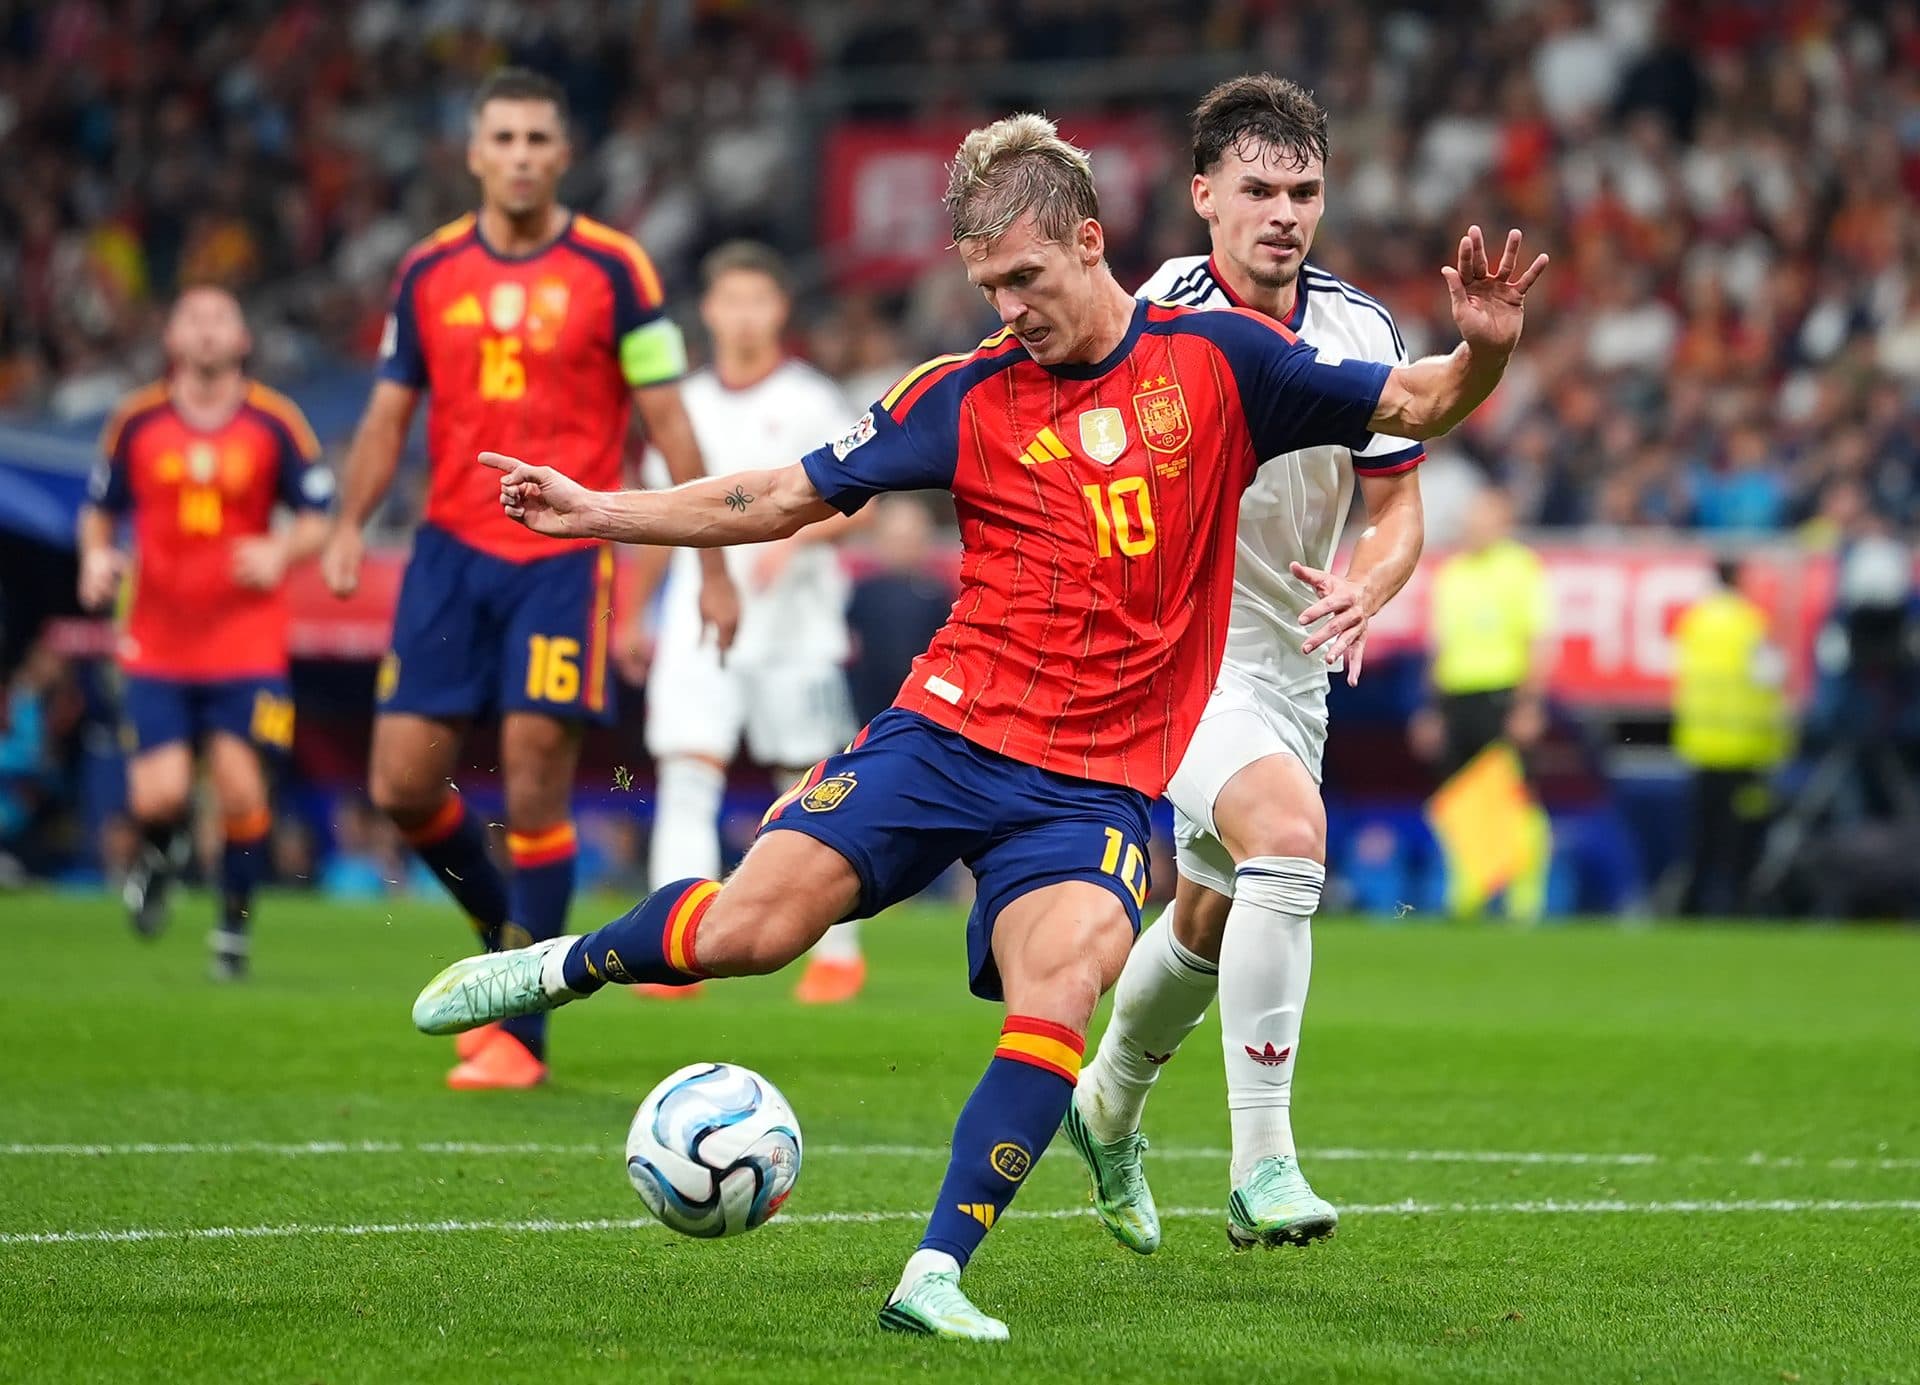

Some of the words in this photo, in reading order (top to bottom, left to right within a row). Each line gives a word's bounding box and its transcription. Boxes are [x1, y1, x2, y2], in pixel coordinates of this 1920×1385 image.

[480, 335, 526, 399] 16
[1082, 475, 1157, 558] 10
[526, 633, 581, 704] 16
[1100, 826, 1147, 910] 10
